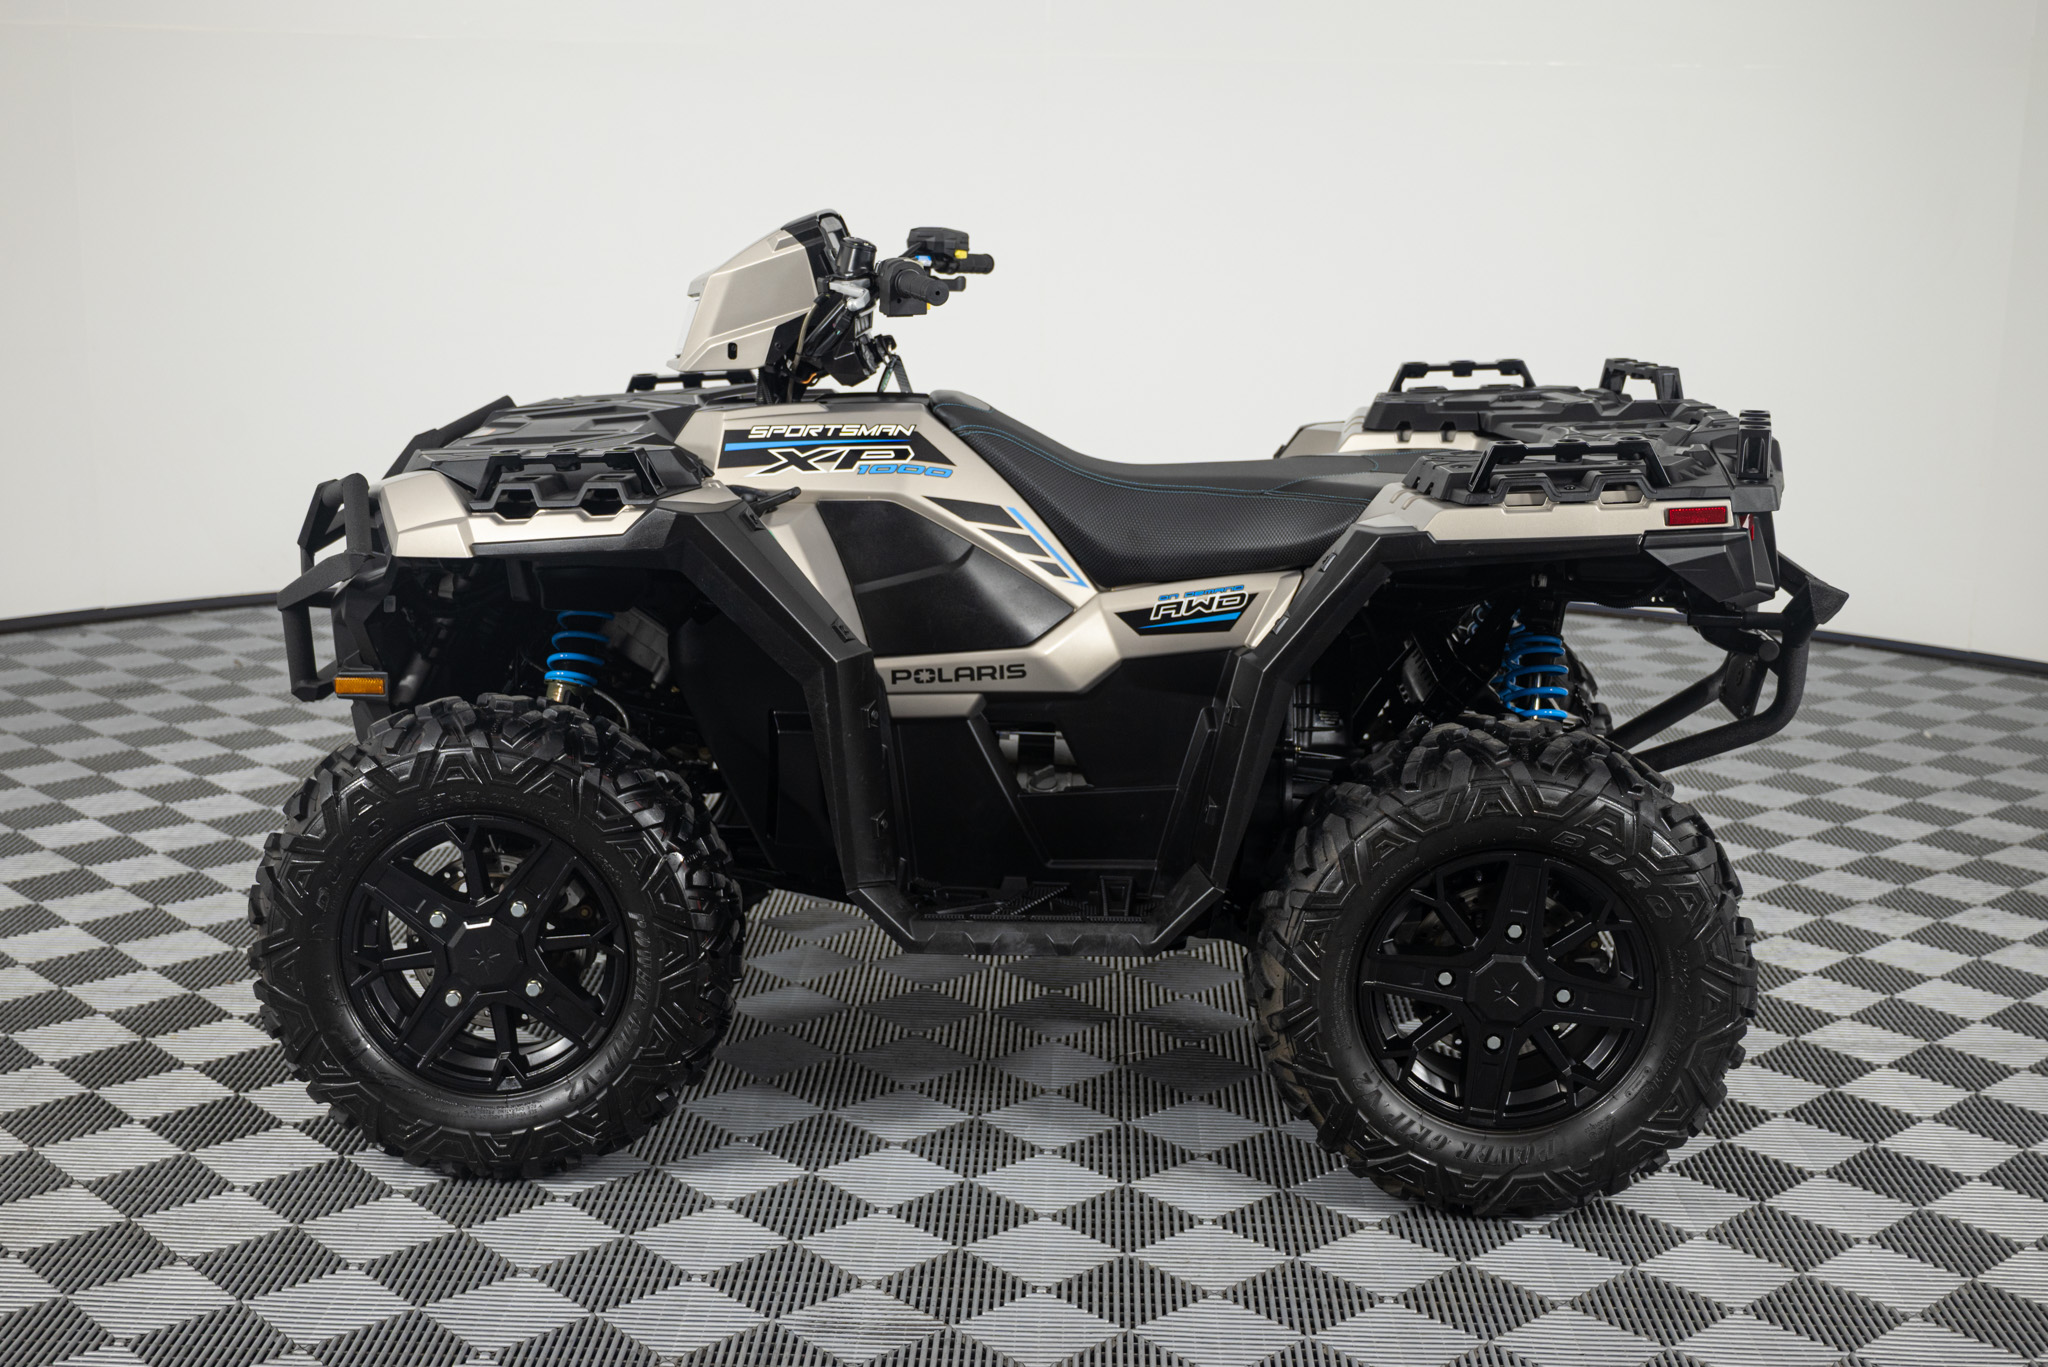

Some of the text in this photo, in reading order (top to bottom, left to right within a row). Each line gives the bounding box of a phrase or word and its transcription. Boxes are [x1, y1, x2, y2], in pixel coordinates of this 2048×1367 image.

[748, 424, 917, 438] SPORTSMAN
[744, 445, 915, 478] XP
[857, 464, 954, 479] 1000
[1184, 585, 1245, 599] DEMAND
[1150, 591, 1249, 621] AWD
[891, 664, 1027, 685] POLARIS
[1551, 831, 1673, 919] DURO
